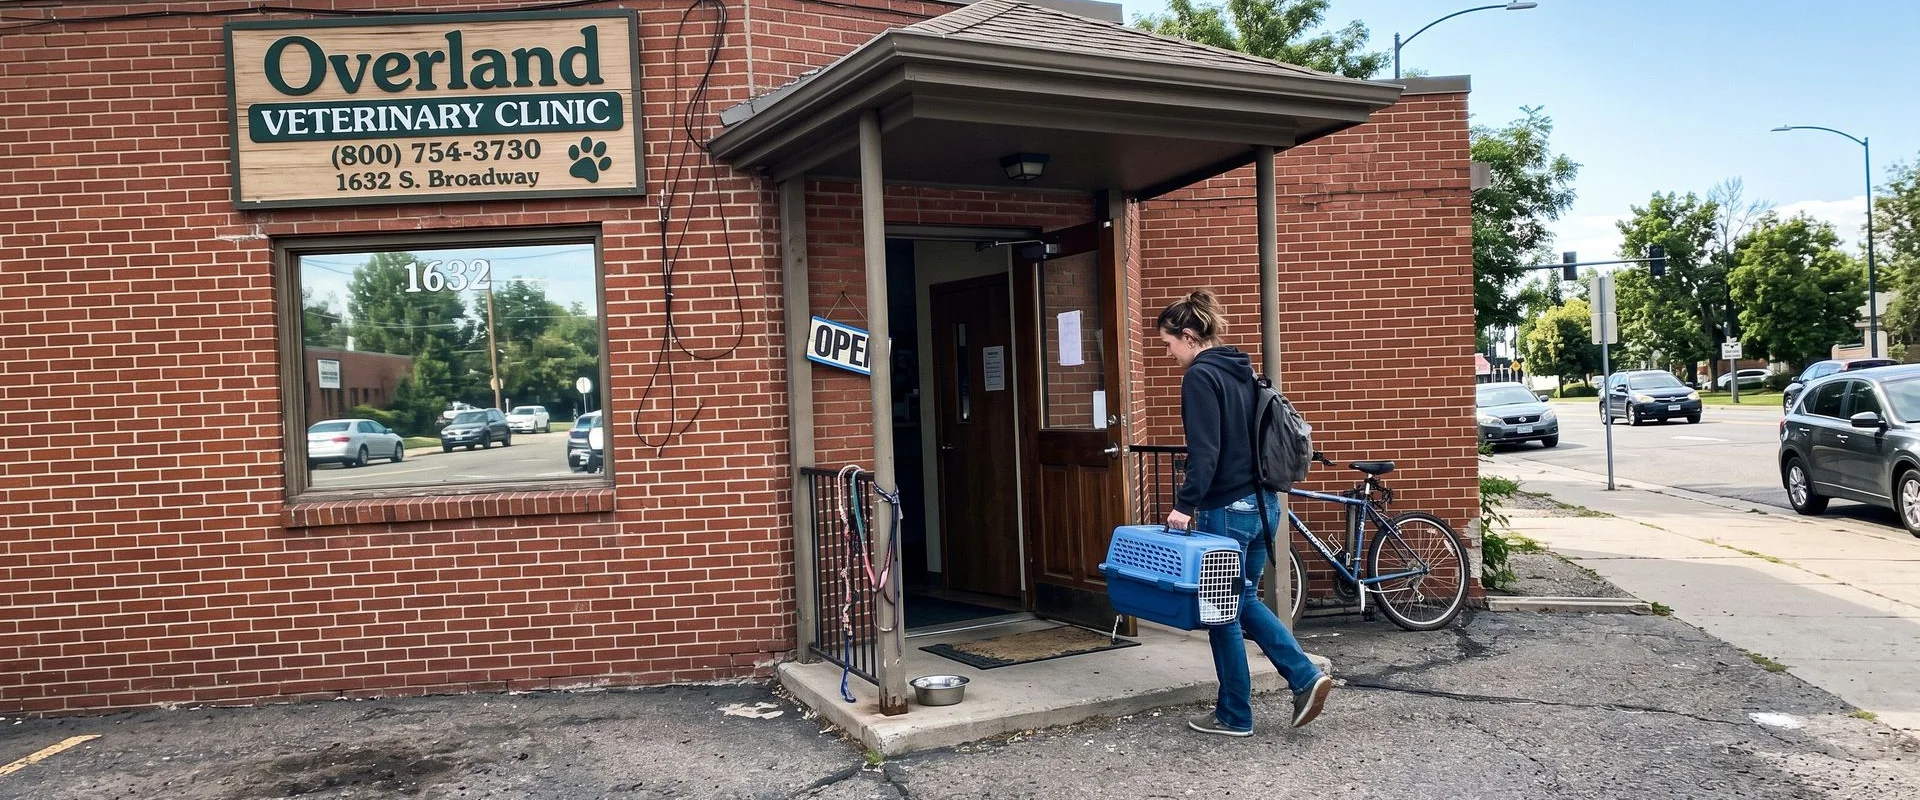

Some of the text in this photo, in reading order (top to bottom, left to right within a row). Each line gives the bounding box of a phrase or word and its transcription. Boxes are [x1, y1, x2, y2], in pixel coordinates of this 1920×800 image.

[264, 25, 605, 96] Overland
[261, 98, 611, 136] VETERINARY CLINIC
[332, 138, 541, 170] (800) 754-3730
[336, 167, 540, 191] 1632 S. Broadway
[403, 258, 491, 293] 1632
